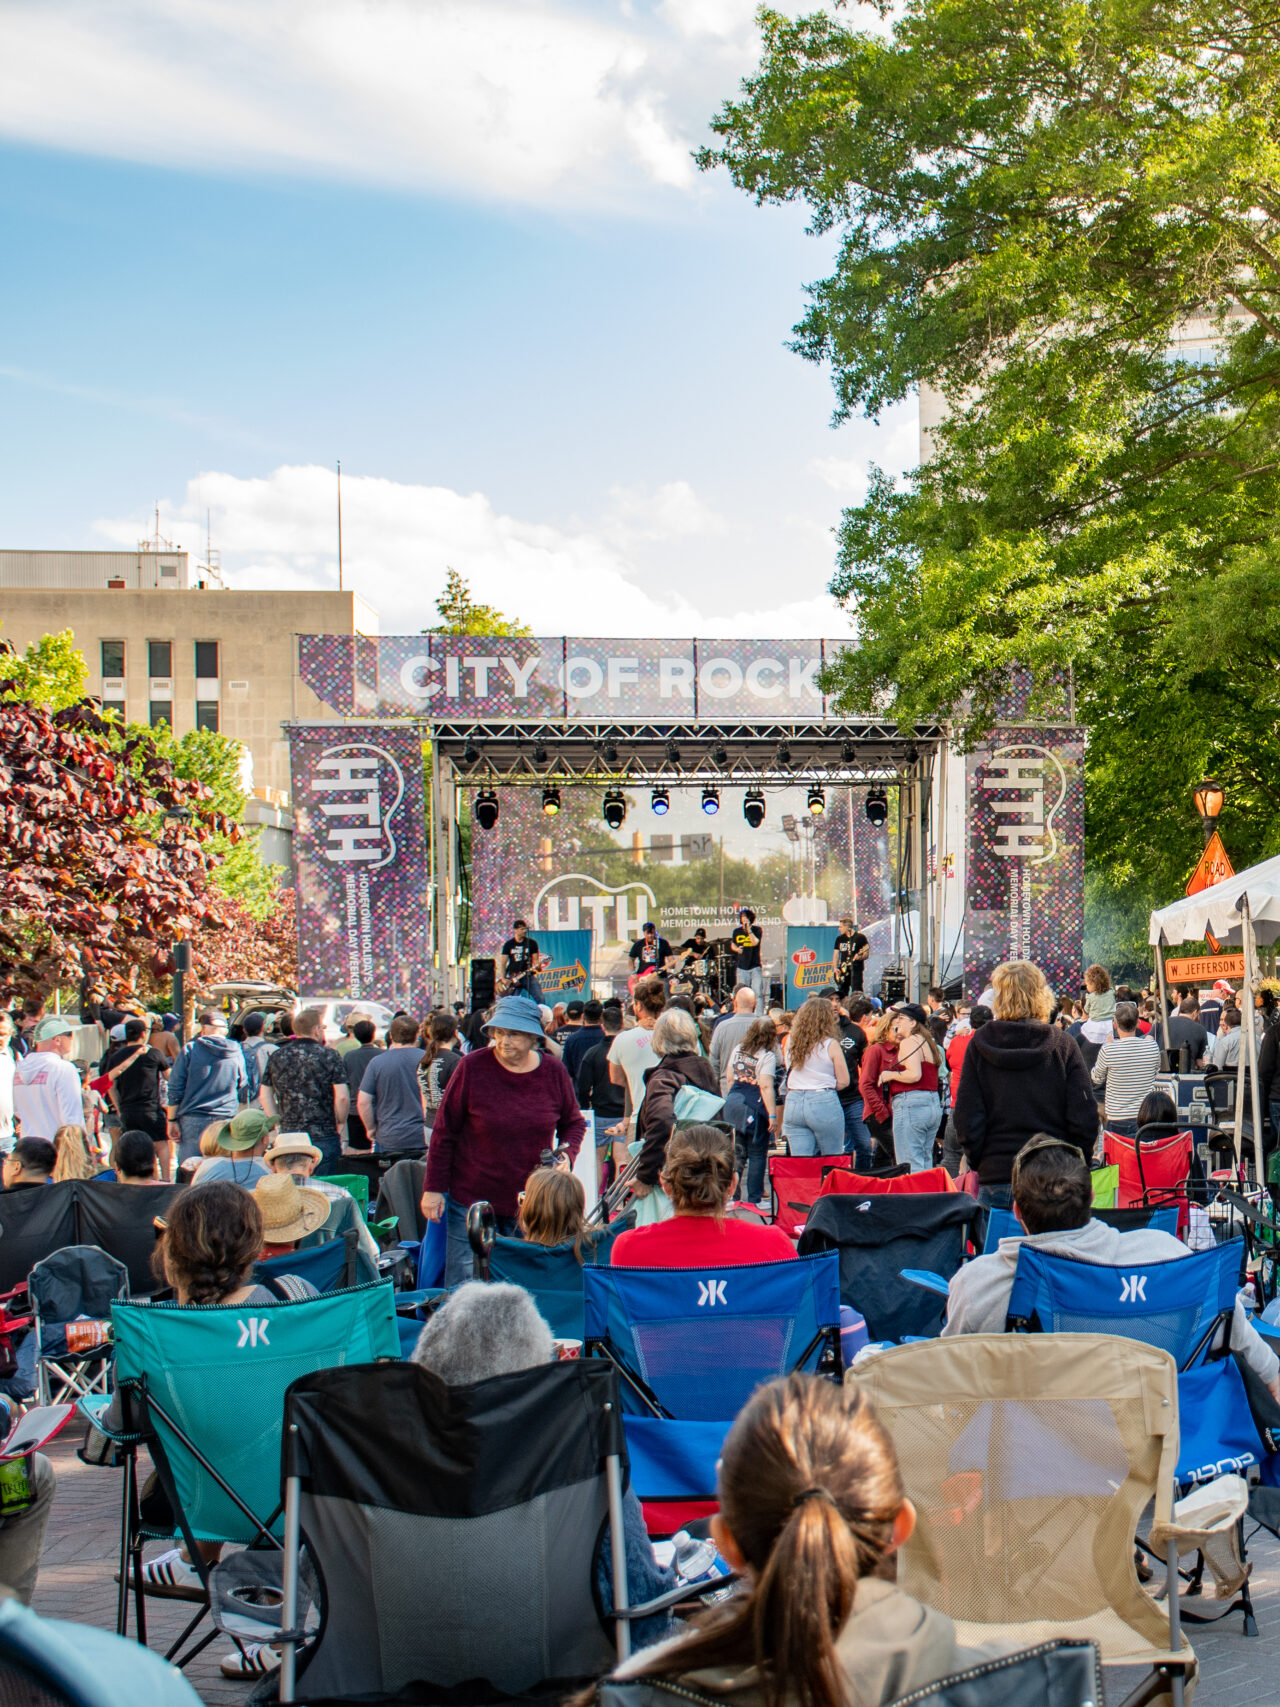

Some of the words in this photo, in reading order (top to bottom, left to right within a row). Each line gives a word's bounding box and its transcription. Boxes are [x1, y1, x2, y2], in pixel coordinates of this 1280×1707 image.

[400, 656, 541, 698] CITY
[558, 656, 639, 698] OF
[659, 657, 824, 698] ROCK
[312, 758, 381, 860] HTH
[983, 758, 1043, 855] HTH
[1205, 861, 1225, 875] ROAD
[346, 874, 357, 928] MEMORIAL
[359, 873, 371, 933] HOMETOWN
[660, 906, 718, 916] HOMETOWN
[1010, 869, 1018, 919] MEMORIAL
[1022, 869, 1031, 924] HOMETOWN
[348, 929, 358, 949] DAY
[660, 918, 711, 928] MEMORIAL
[713, 918, 733, 927] DAY
[1010, 921, 1018, 939] DAY
[362, 934, 374, 983] HOLIDAYS
[1010, 941, 1018, 961] WEE
[1022, 926, 1031, 961] HOLIDA
[349, 950, 360, 999] WEEKEND
[802, 974, 827, 985] TOUR
[1171, 965, 1182, 976] W.
[1185, 960, 1236, 975] JEFFERSON
